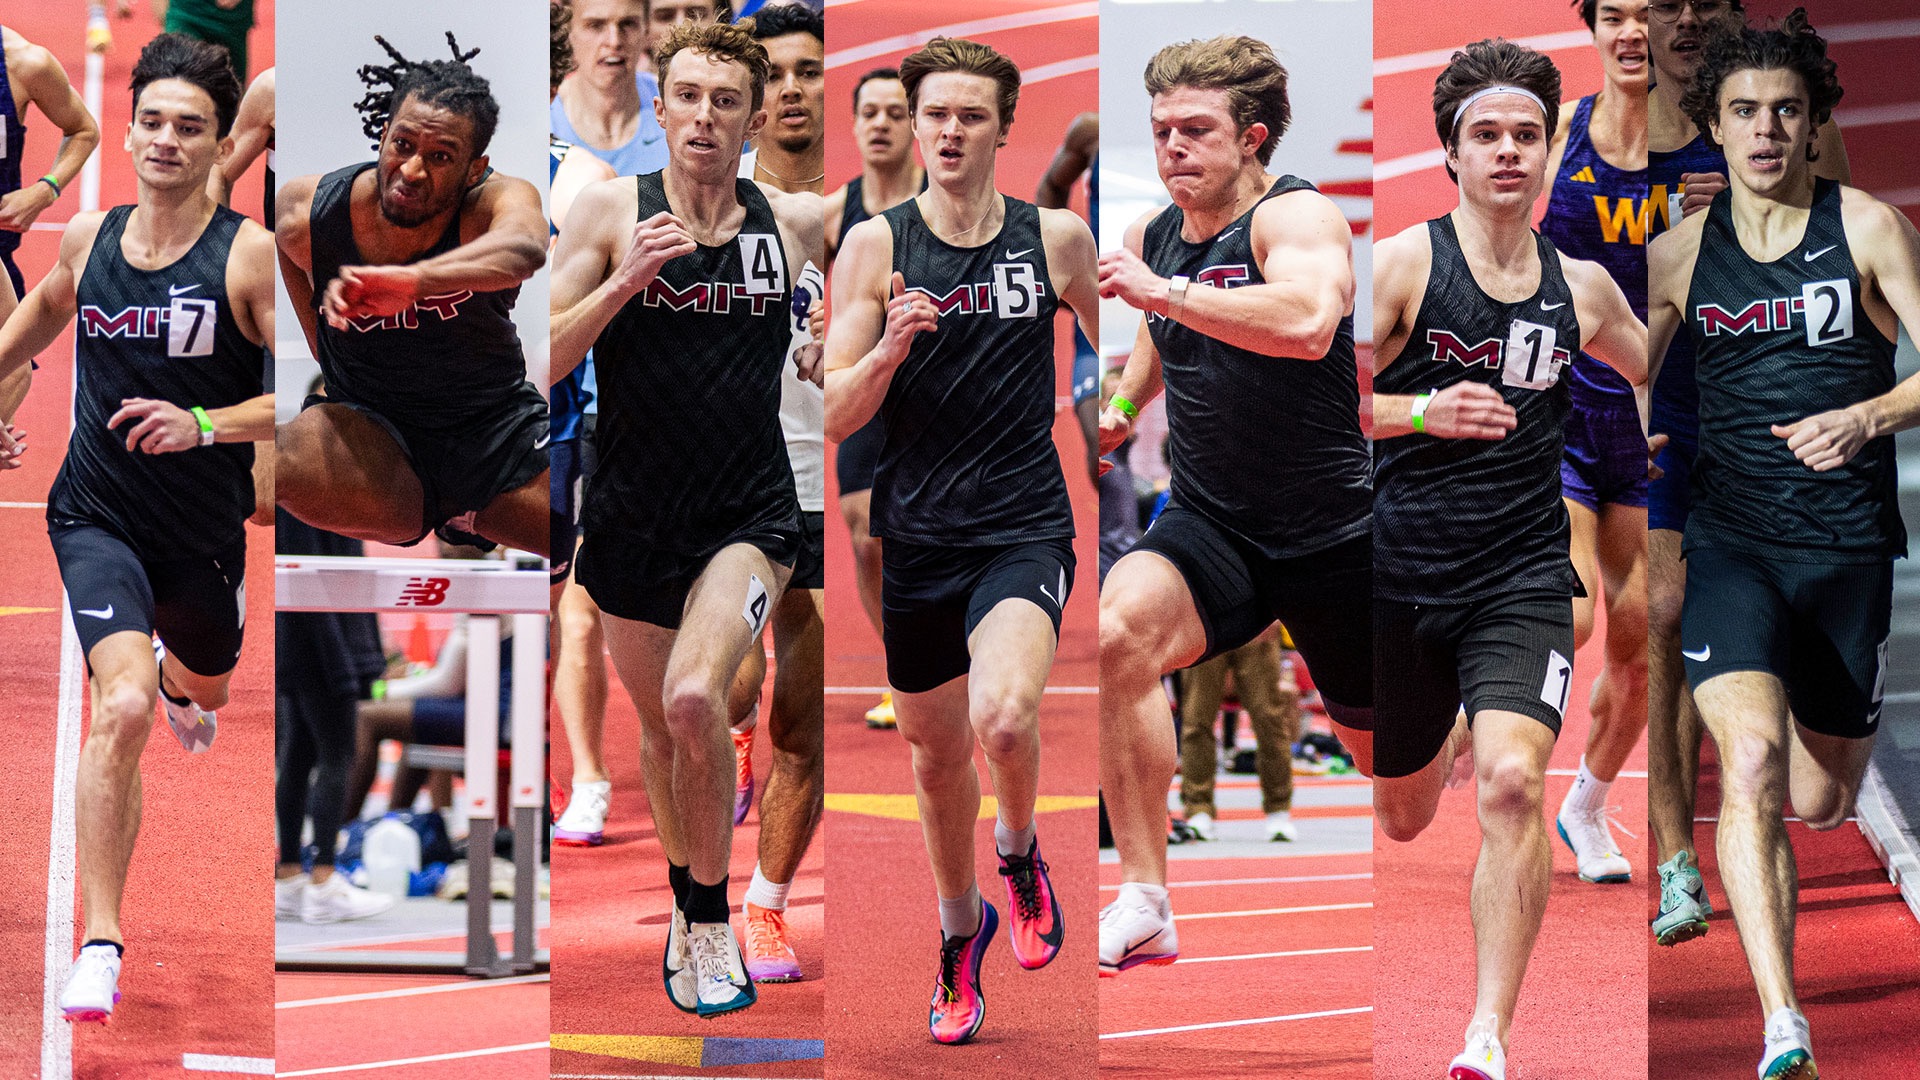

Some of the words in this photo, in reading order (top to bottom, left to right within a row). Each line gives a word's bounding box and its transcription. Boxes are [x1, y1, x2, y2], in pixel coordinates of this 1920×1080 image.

[751, 238, 779, 290] 4
[642, 276, 783, 316] MIT
[1004, 266, 1031, 315] 5
[1813, 285, 1845, 342] 2
[181, 303, 206, 354] 7
[1523, 328, 1543, 384] 1
[1558, 666, 1571, 713] 1
